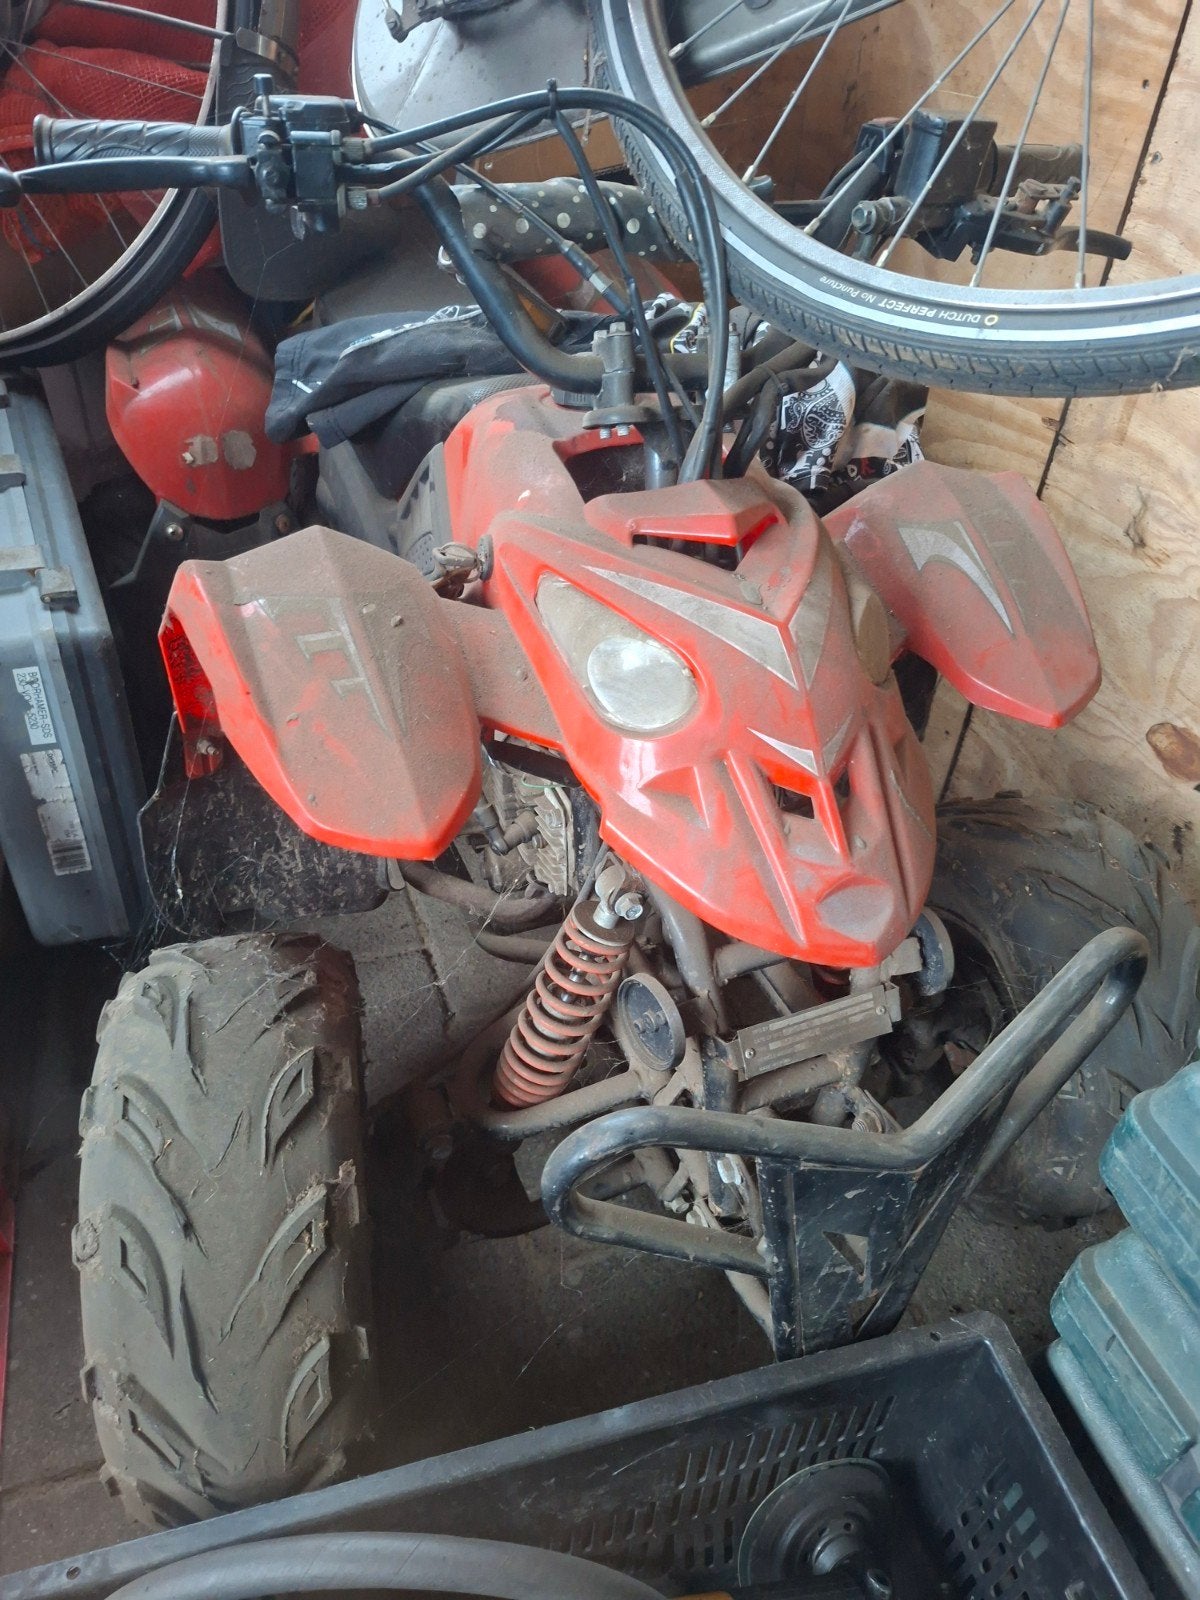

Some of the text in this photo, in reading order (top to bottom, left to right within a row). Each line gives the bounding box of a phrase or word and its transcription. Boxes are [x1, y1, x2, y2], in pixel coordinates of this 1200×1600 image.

[819, 275, 981, 324] DUTCH PERFECT No Puncture
